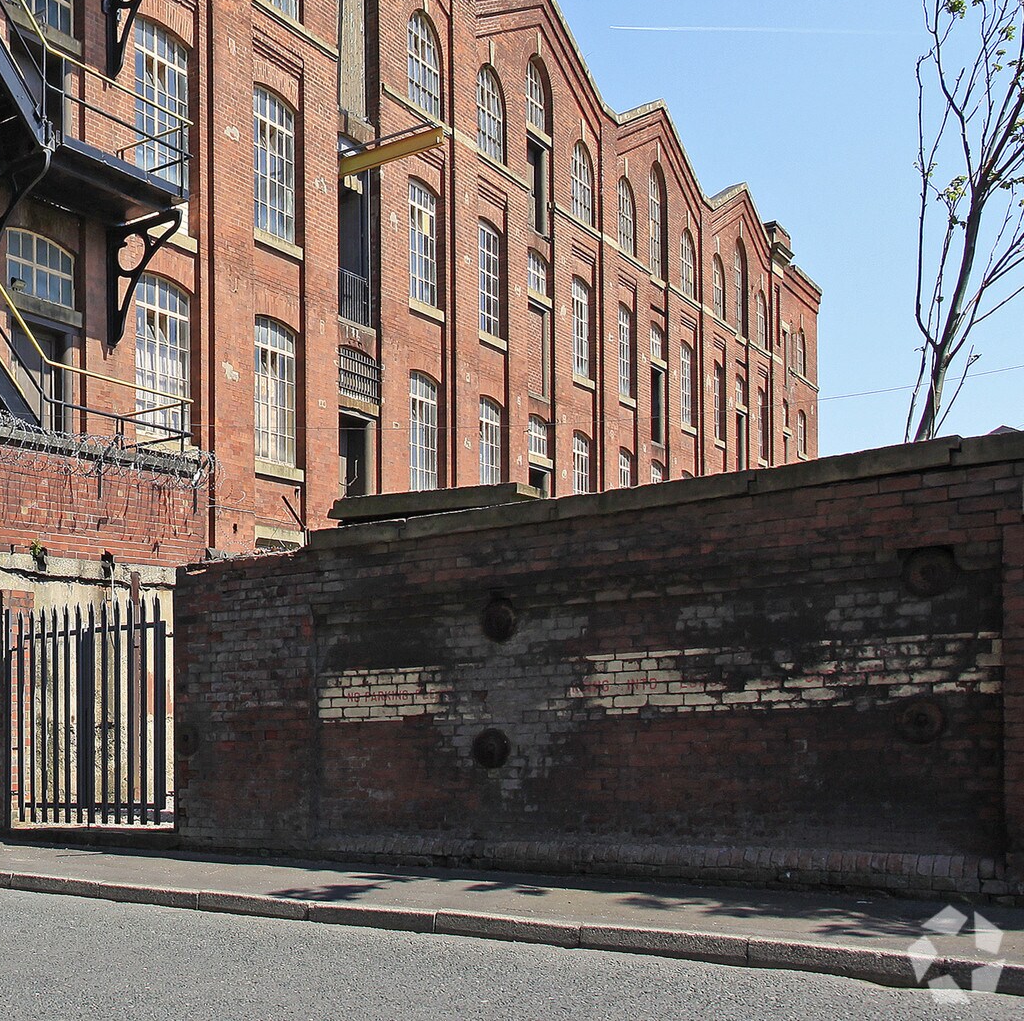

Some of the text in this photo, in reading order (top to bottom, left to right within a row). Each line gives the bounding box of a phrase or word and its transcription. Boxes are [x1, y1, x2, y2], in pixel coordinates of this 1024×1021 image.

[347, 691, 360, 703] NO
[364, 689, 409, 703] PARKING
[626, 677, 658, 691] INTO
